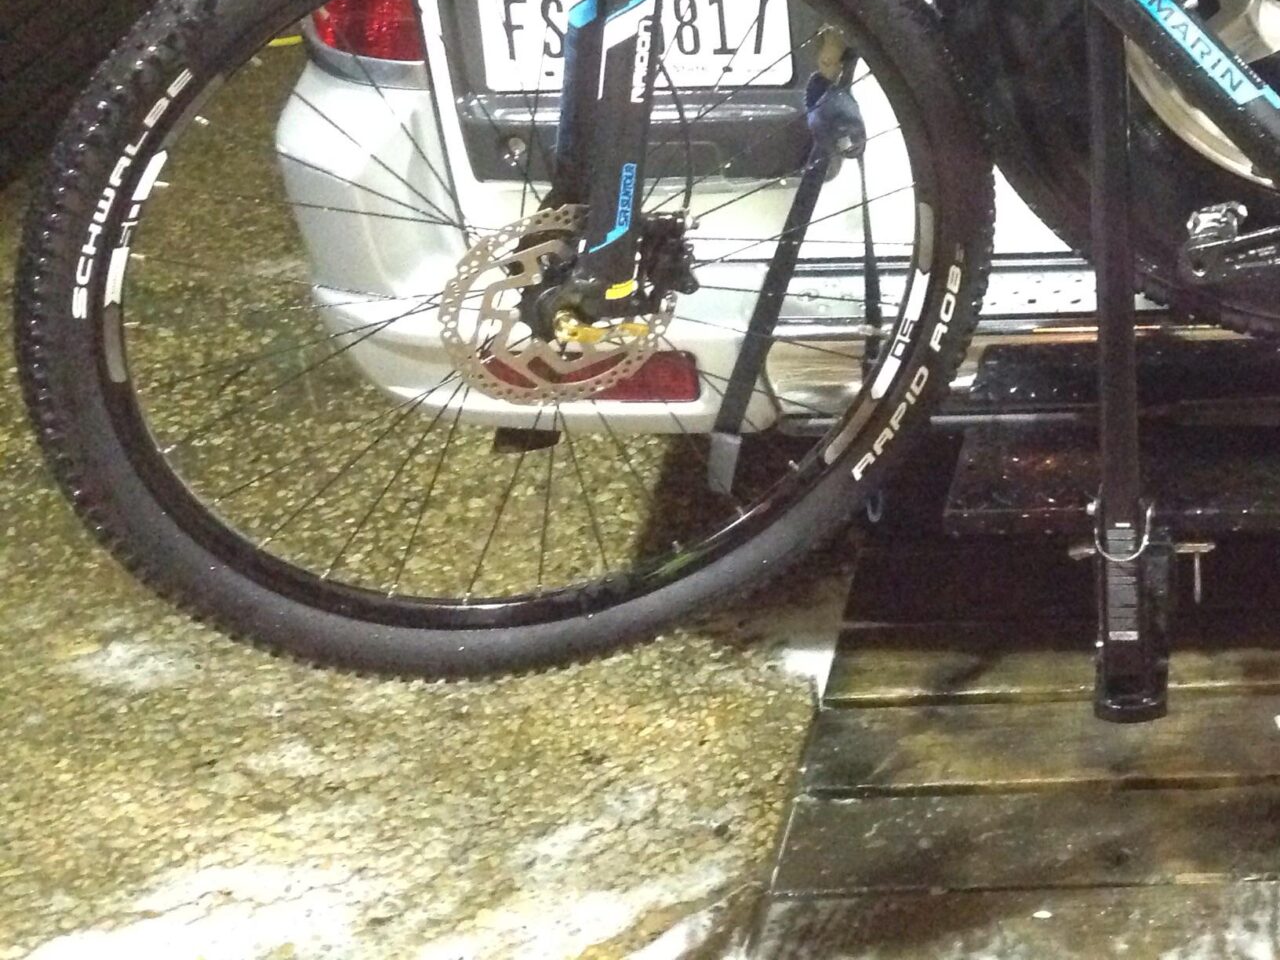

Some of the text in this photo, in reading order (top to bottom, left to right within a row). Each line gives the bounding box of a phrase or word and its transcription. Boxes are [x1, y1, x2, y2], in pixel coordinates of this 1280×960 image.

[71, 68, 194, 320] SCHWALBE
[851, 263, 963, 482] RAPID ROB
